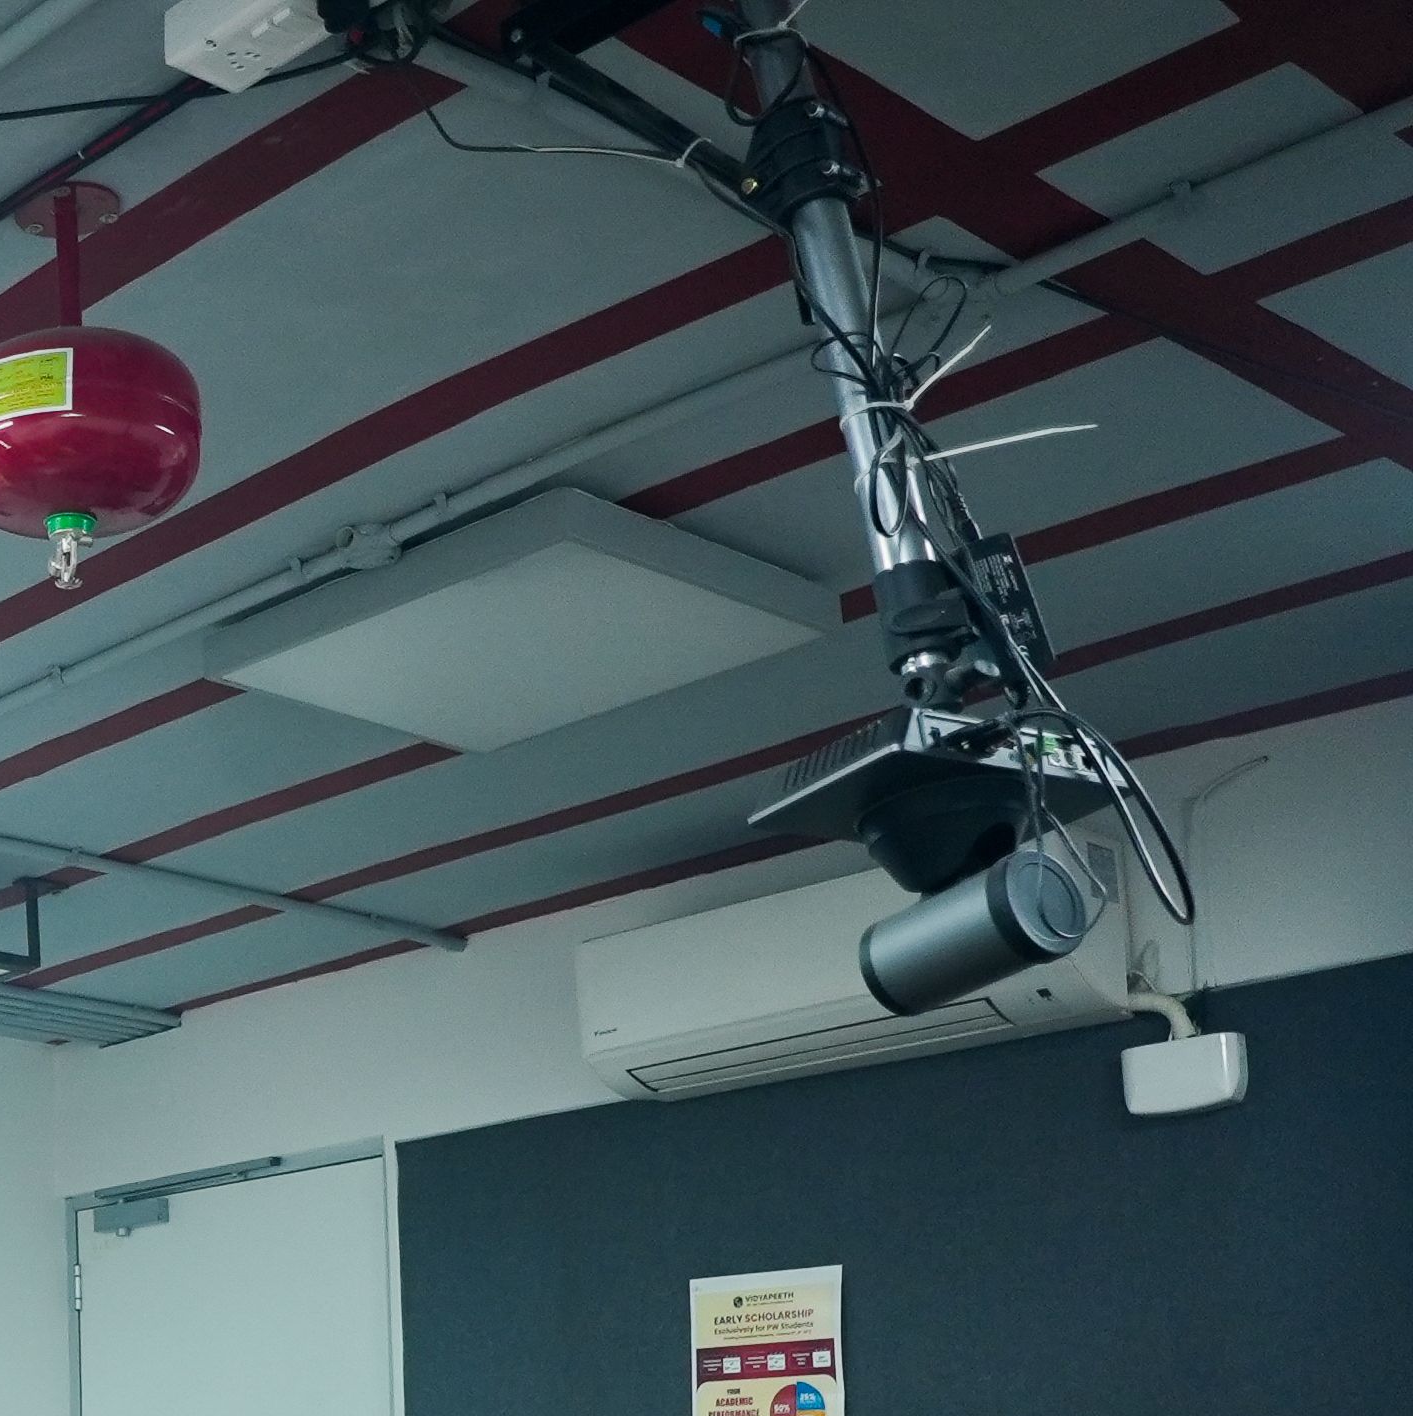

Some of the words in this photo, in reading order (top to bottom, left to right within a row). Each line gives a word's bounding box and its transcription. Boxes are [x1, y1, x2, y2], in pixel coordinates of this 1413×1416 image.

[714, 1314, 743, 1326] EARLY
[744, 1308, 814, 1323] SCHOLARSHIP
[780, 1321, 814, 1330] Students
[715, 1396, 754, 1407] ACADEMIC
